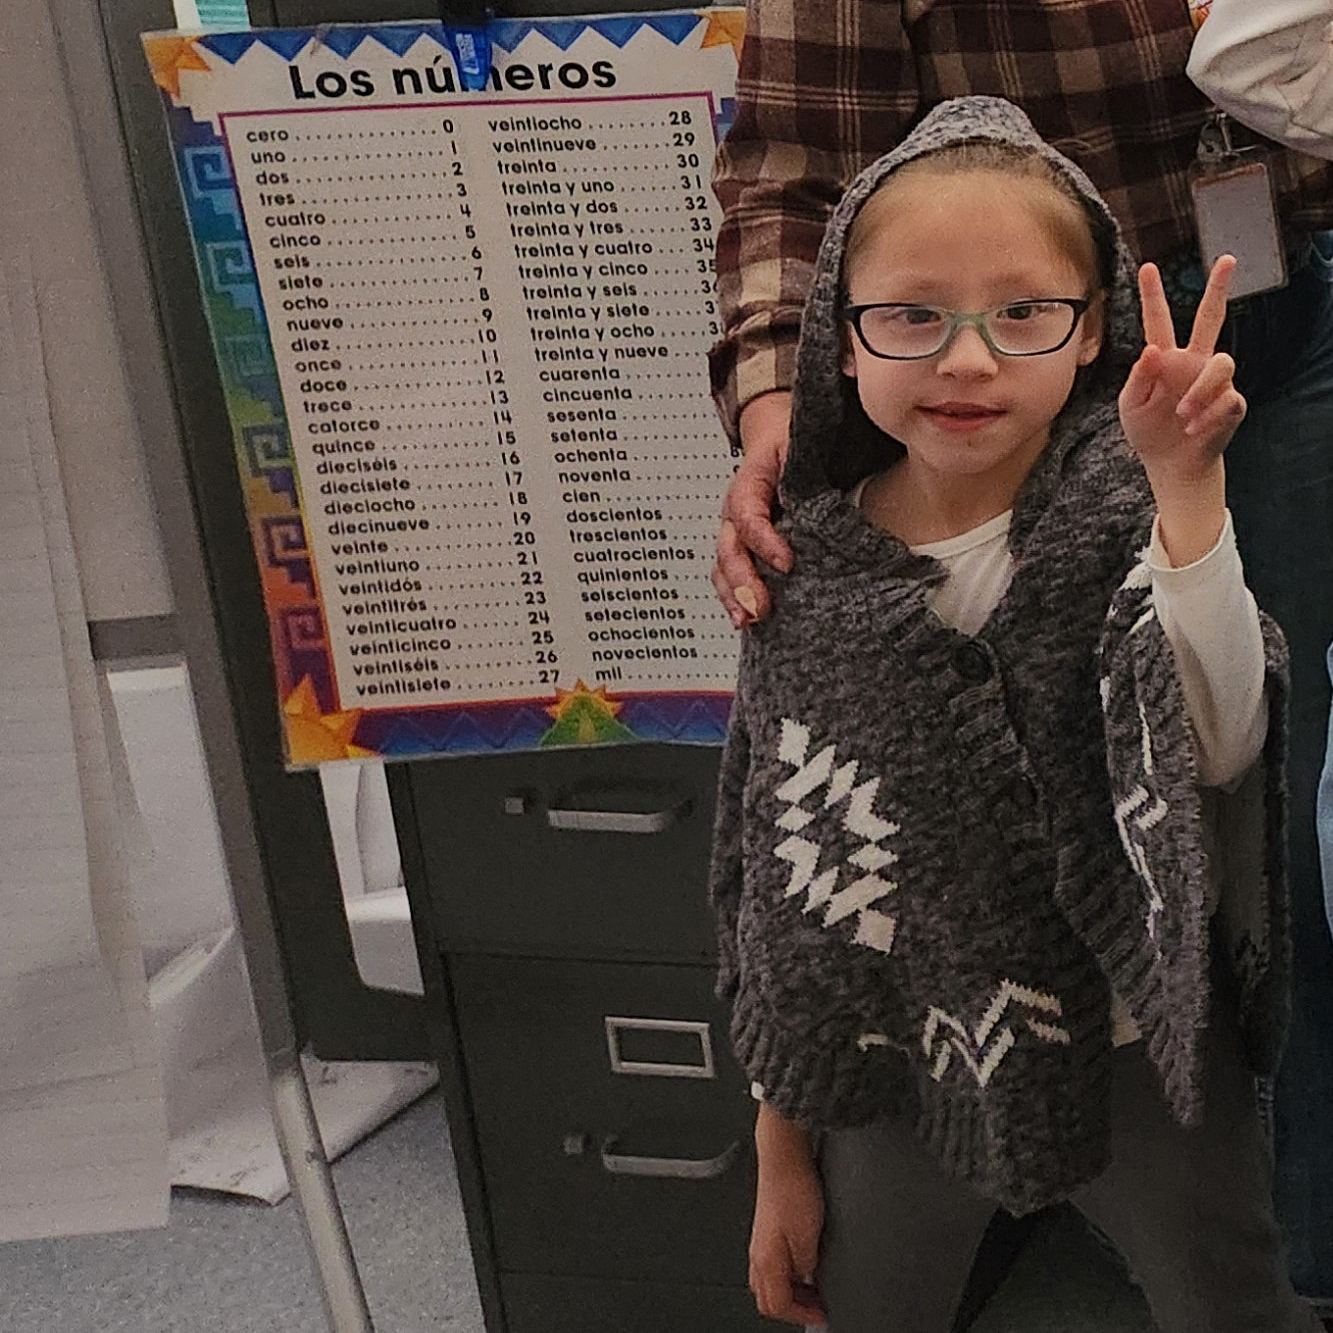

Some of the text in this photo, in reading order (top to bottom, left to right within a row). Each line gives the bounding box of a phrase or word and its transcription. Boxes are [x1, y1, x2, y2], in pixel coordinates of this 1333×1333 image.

[288, 65, 375, 100] Los
[246, 119, 454, 143] cero 0
[251, 150, 286, 164] uno
[256, 161, 463, 185] dos 2
[259, 183, 467, 207] tres 3
[265, 203, 471, 228] cuatro 4
[270, 224, 476, 249] cinco 5
[274, 245, 482, 269] seis 6
[278, 266, 483, 291] siete 7
[282, 287, 490, 311] ocho 8
[286, 308, 492, 332] nueve 9
[290, 328, 497, 353] diez 10
[295, 349, 499, 373] once 11
[300, 370, 505, 394] doce 12
[303, 390, 509, 414] trece 13
[308, 409, 512, 435] catorce 14
[312, 431, 516, 456] quince 15
[501, 451, 521, 465] 16
[320, 471, 523, 495] diecisiete 17
[324, 491, 528, 515] dieciocho 18
[328, 511, 531, 536] diecinueve 19
[331, 531, 535, 556] veinte 20
[335, 551, 538, 575] veintiuno 21
[520, 571, 544, 585] 22
[524, 591, 547, 606] 23
[346, 610, 550, 635] veinticuatro 24
[349, 631, 554, 656] veinticinco 25
[535, 650, 558, 664] 26
[356, 669, 560, 696] veintisiete 27
